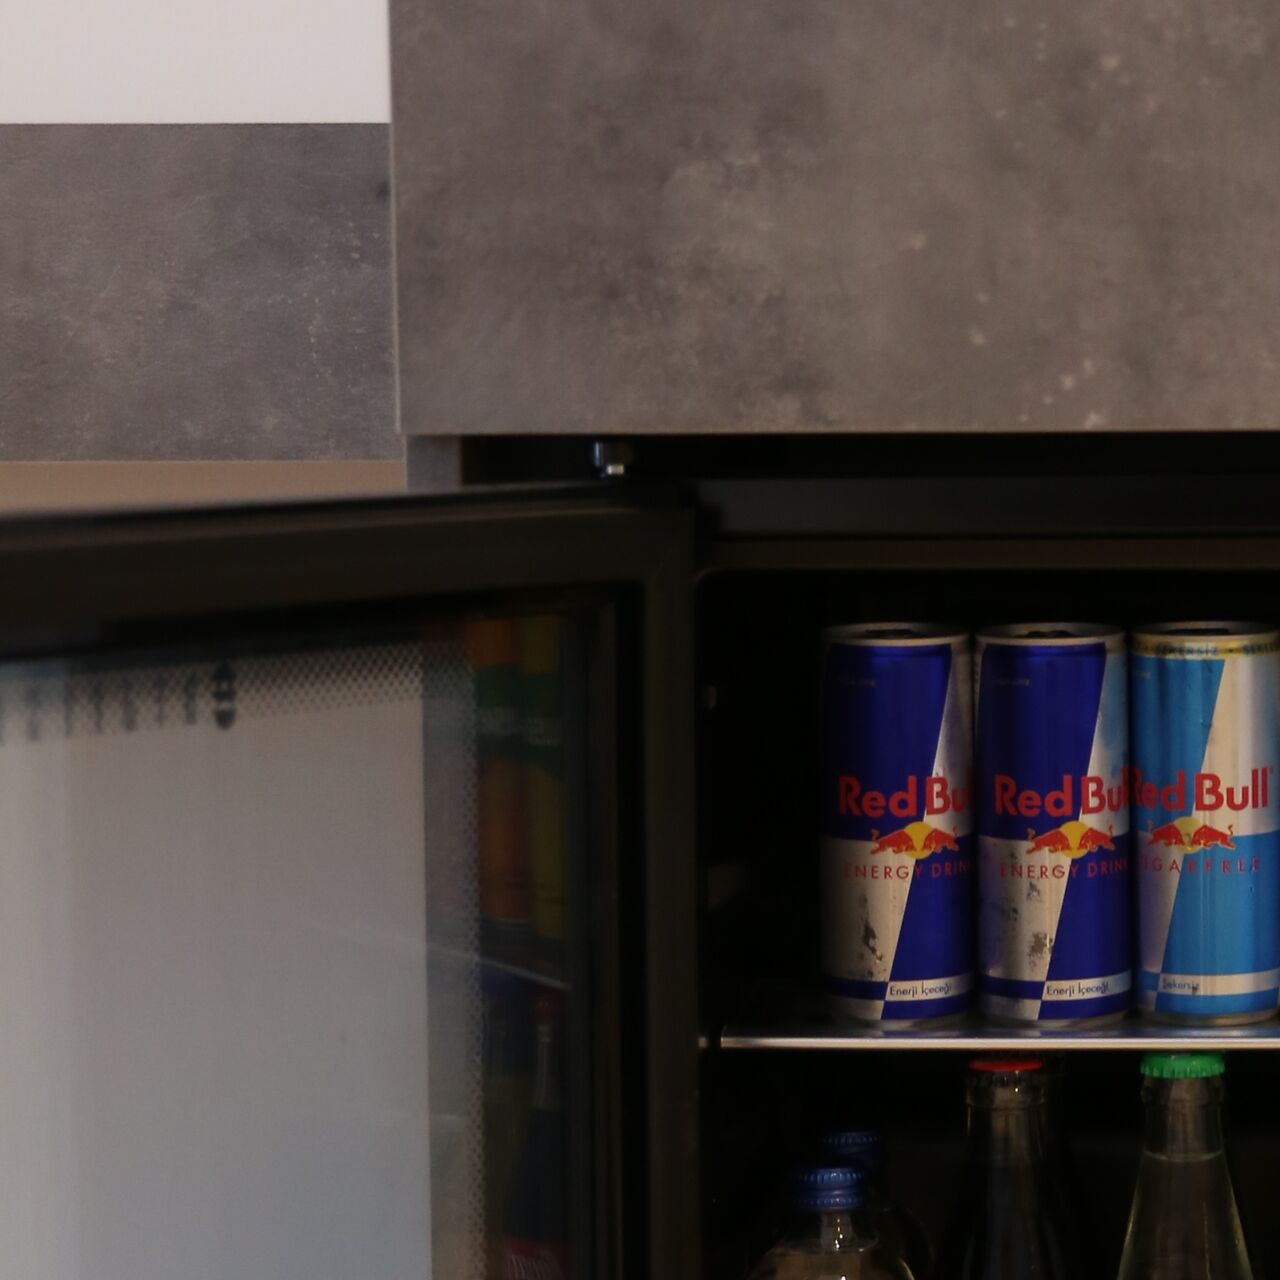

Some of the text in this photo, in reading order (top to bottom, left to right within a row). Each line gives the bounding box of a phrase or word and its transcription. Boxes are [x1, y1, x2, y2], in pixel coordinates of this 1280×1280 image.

[837, 774, 973, 818] Red Bu
[994, 774, 1073, 818] Red
[1195, 767, 1268, 811] Bull
[843, 863, 922, 880] ENERGY
[1000, 863, 1079, 880] ENERGY
[890, 984, 918, 997] Enerji
[1046, 984, 1074, 997] Enerji
